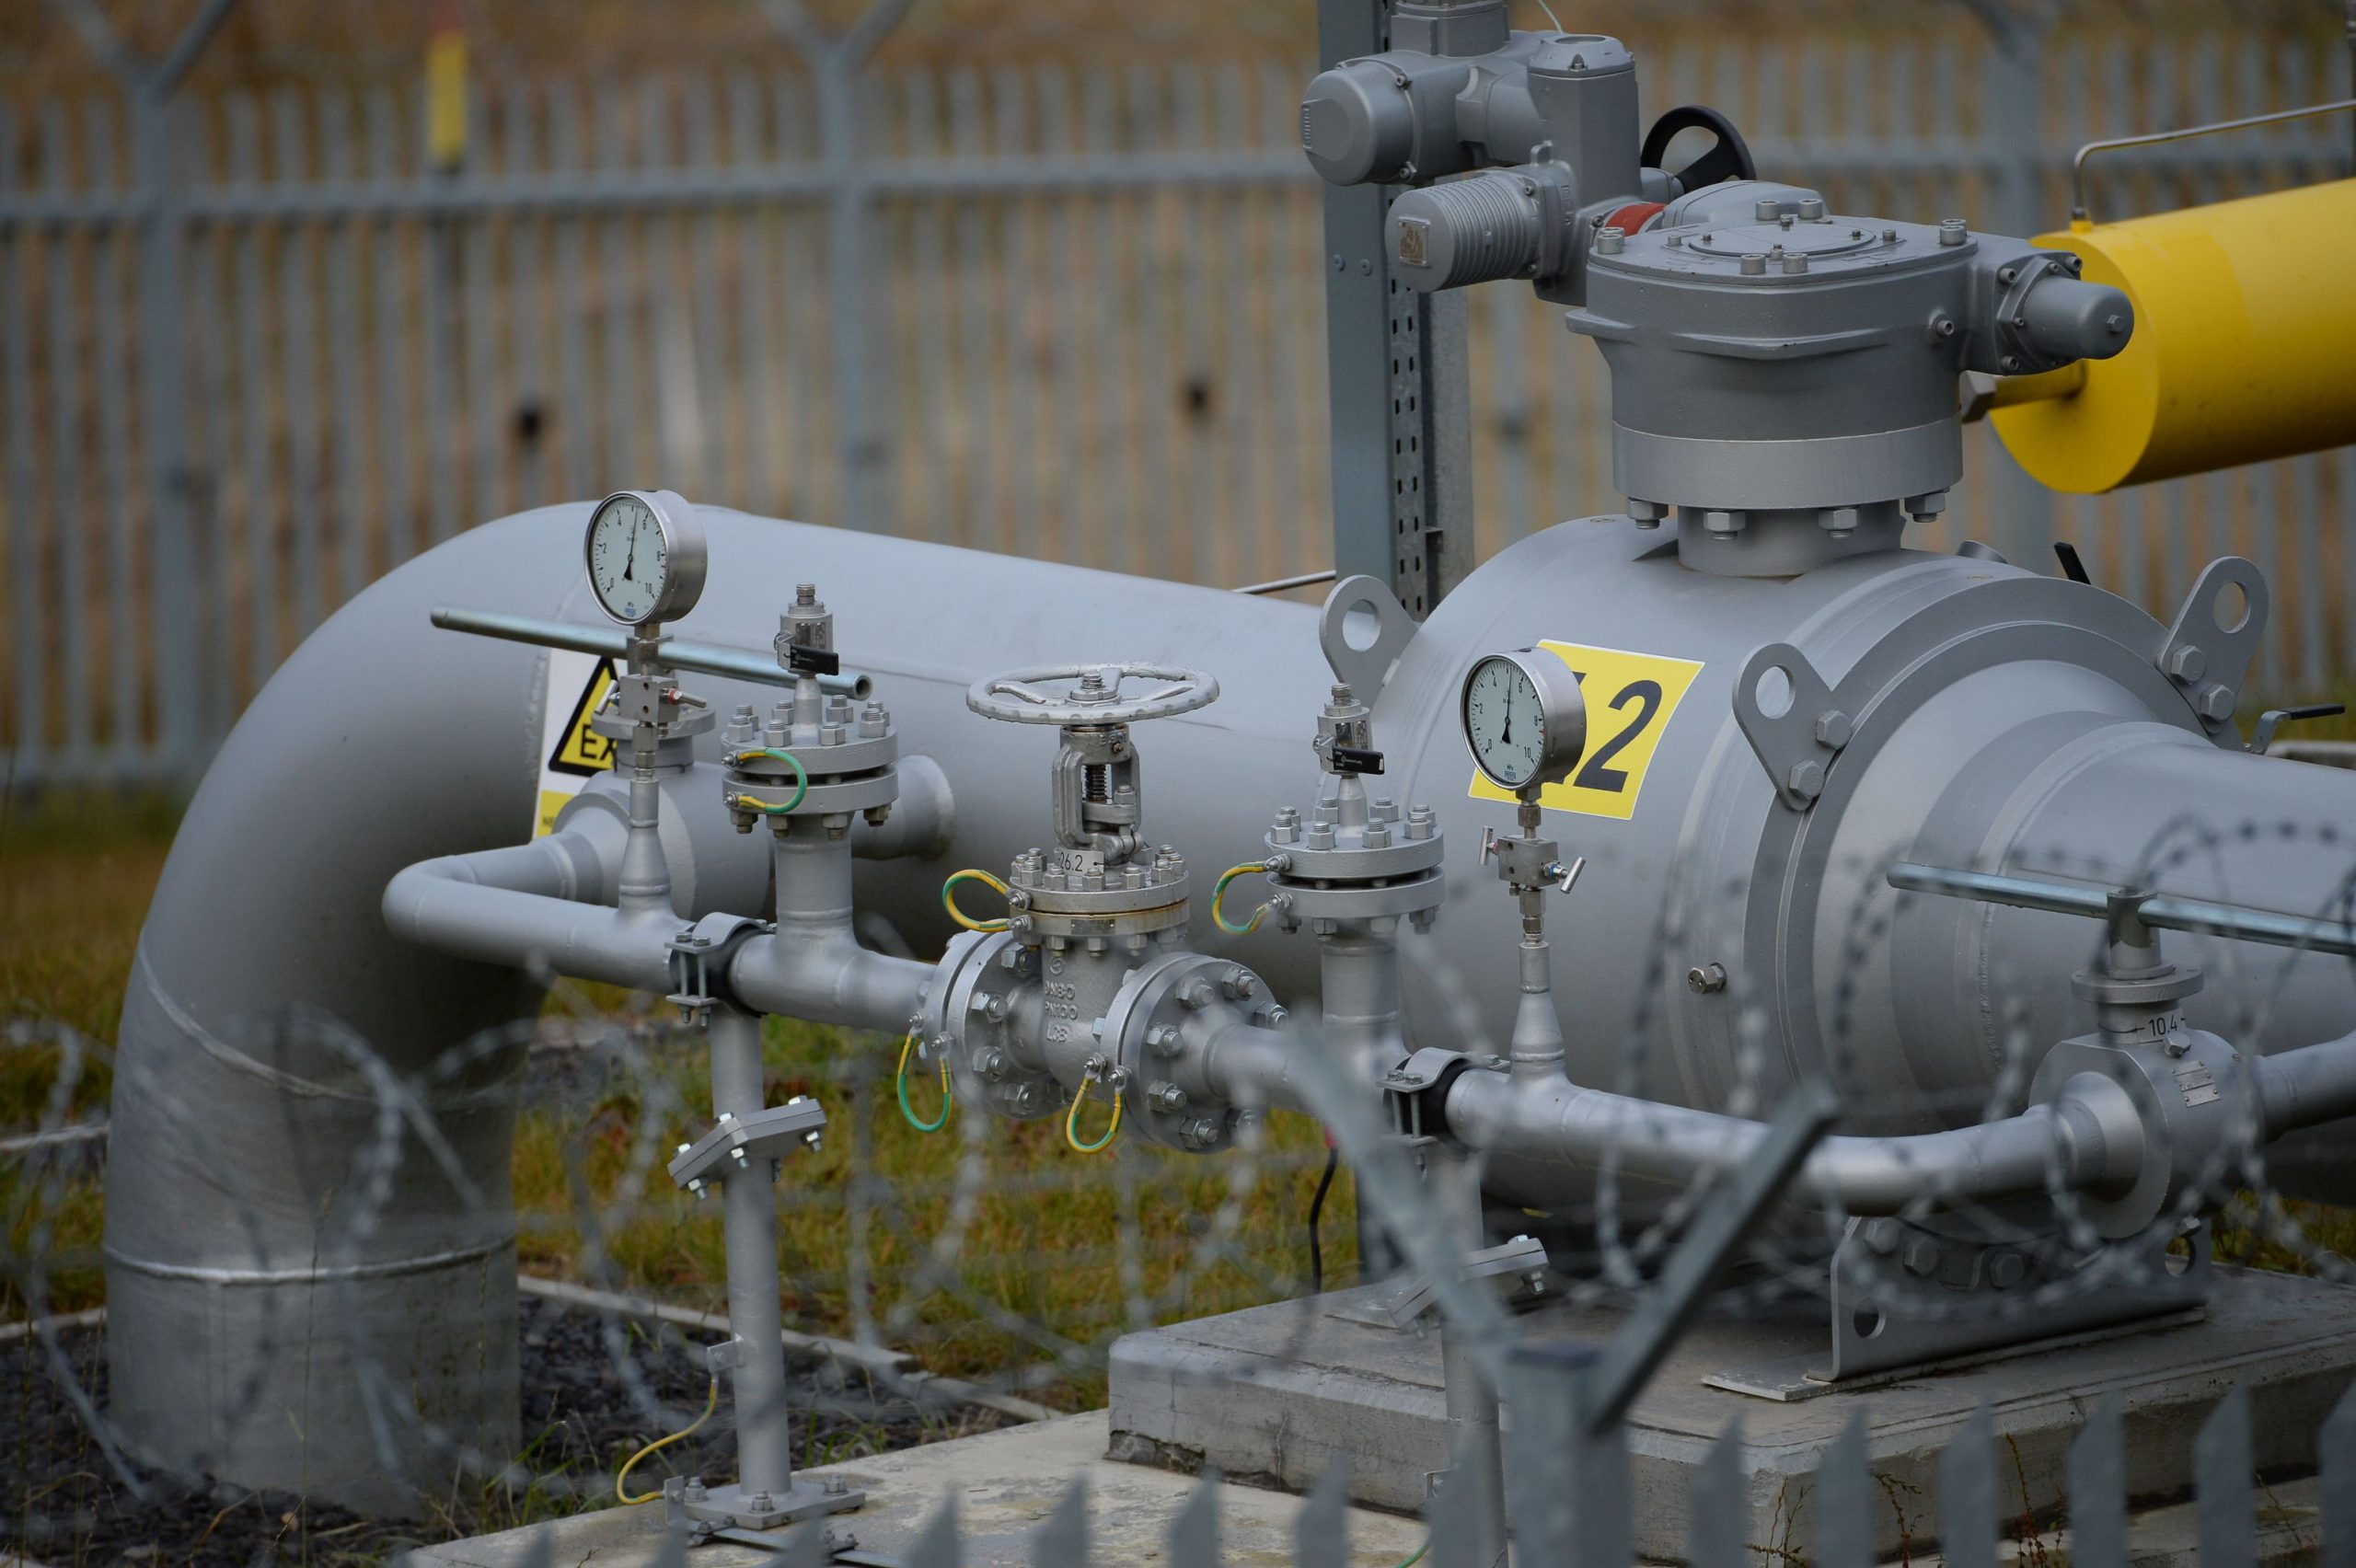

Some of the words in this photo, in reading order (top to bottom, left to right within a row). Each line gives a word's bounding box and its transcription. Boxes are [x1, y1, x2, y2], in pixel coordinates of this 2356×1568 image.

[603, 543, 606, 553] 2
[645, 582, 653, 594] 10
[1493, 676, 1497, 687] 4
[1518, 682, 1522, 693] 6
[1479, 703, 1483, 714] 2
[1533, 715, 1538, 726] 8
[1546, 671, 1662, 793] 2
[1488, 739, 1492, 749] 0
[1524, 746, 1530, 758] 10
[2148, 1014, 2178, 1037] 10.4
